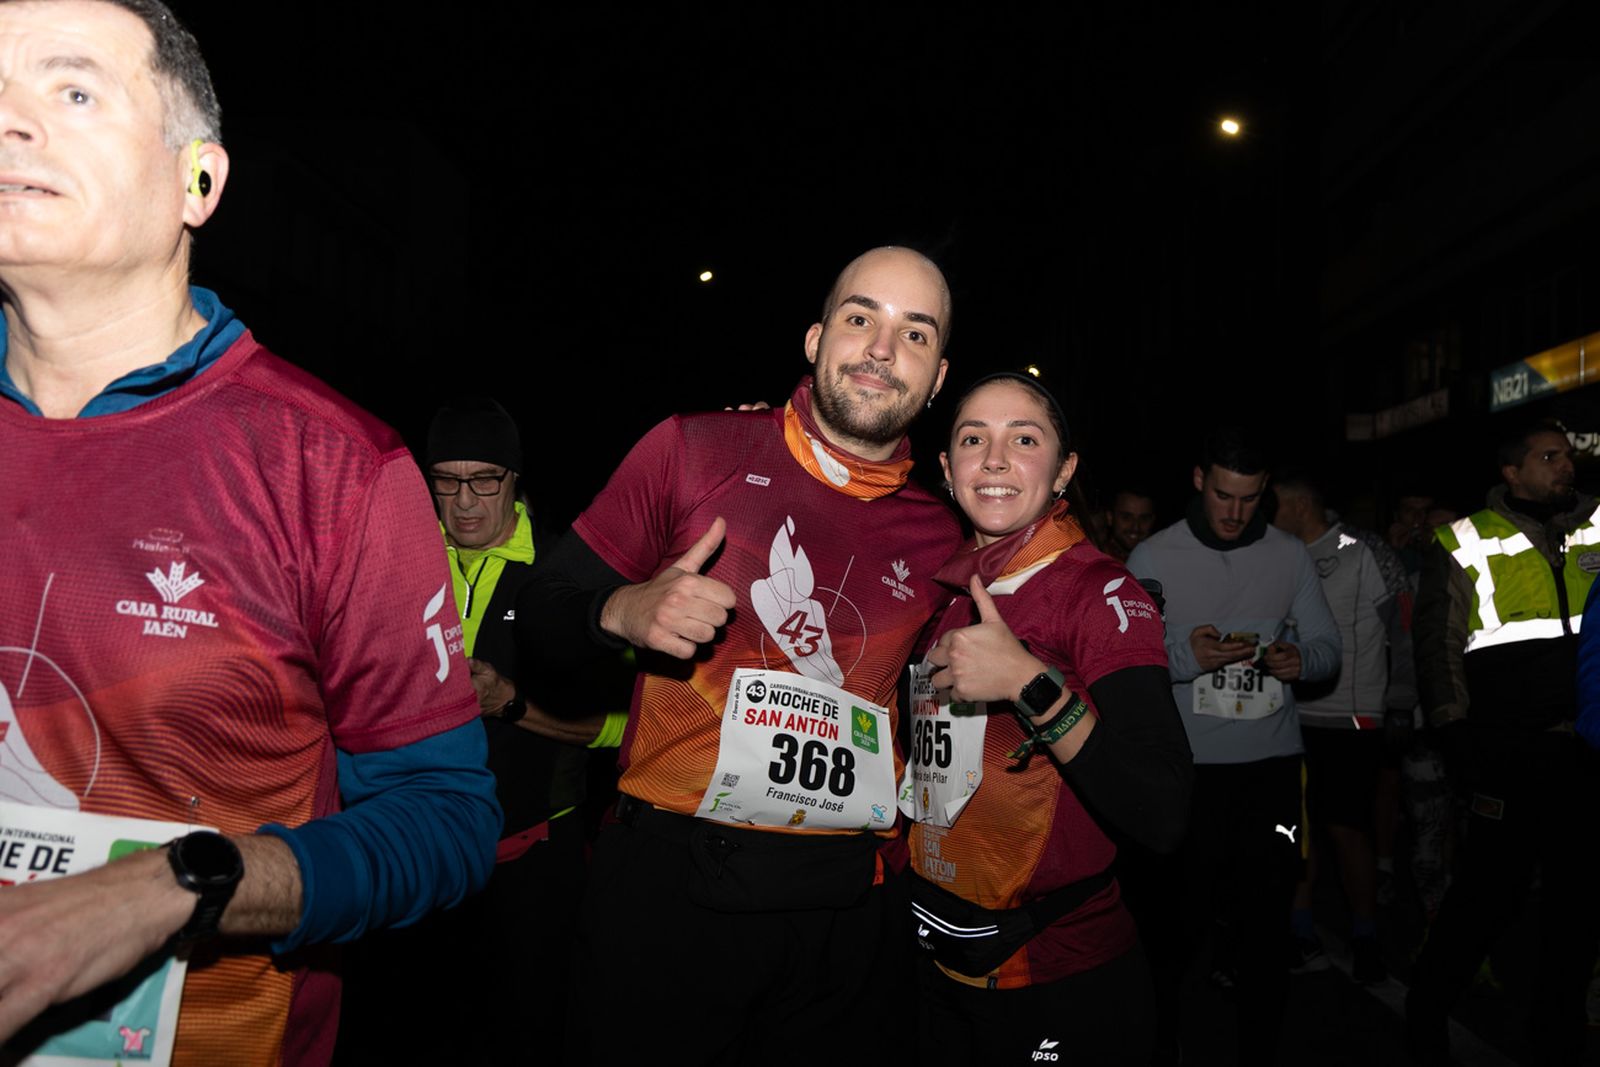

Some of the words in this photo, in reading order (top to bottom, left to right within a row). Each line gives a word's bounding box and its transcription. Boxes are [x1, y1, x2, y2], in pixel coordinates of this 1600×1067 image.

[1493, 372, 1528, 405] NB21
[160, 605, 219, 628] RURAL
[776, 610, 824, 657] 43
[746, 684, 766, 698] 43
[1213, 667, 1263, 693] 6531
[768, 690, 820, 714] NOCHE
[822, 702, 839, 720] DE
[744, 708, 783, 728] SAN
[784, 712, 839, 741] ANTÓN
[913, 720, 952, 768] 365
[768, 733, 856, 797] 368
[932, 772, 948, 784] Pilar
[766, 787, 817, 808] Francisco
[819, 798, 844, 813] José
[5, 828, 75, 844] INTERNACIONAL
[28, 845, 74, 874] DE
[1031, 1051, 1059, 1061] ipso
